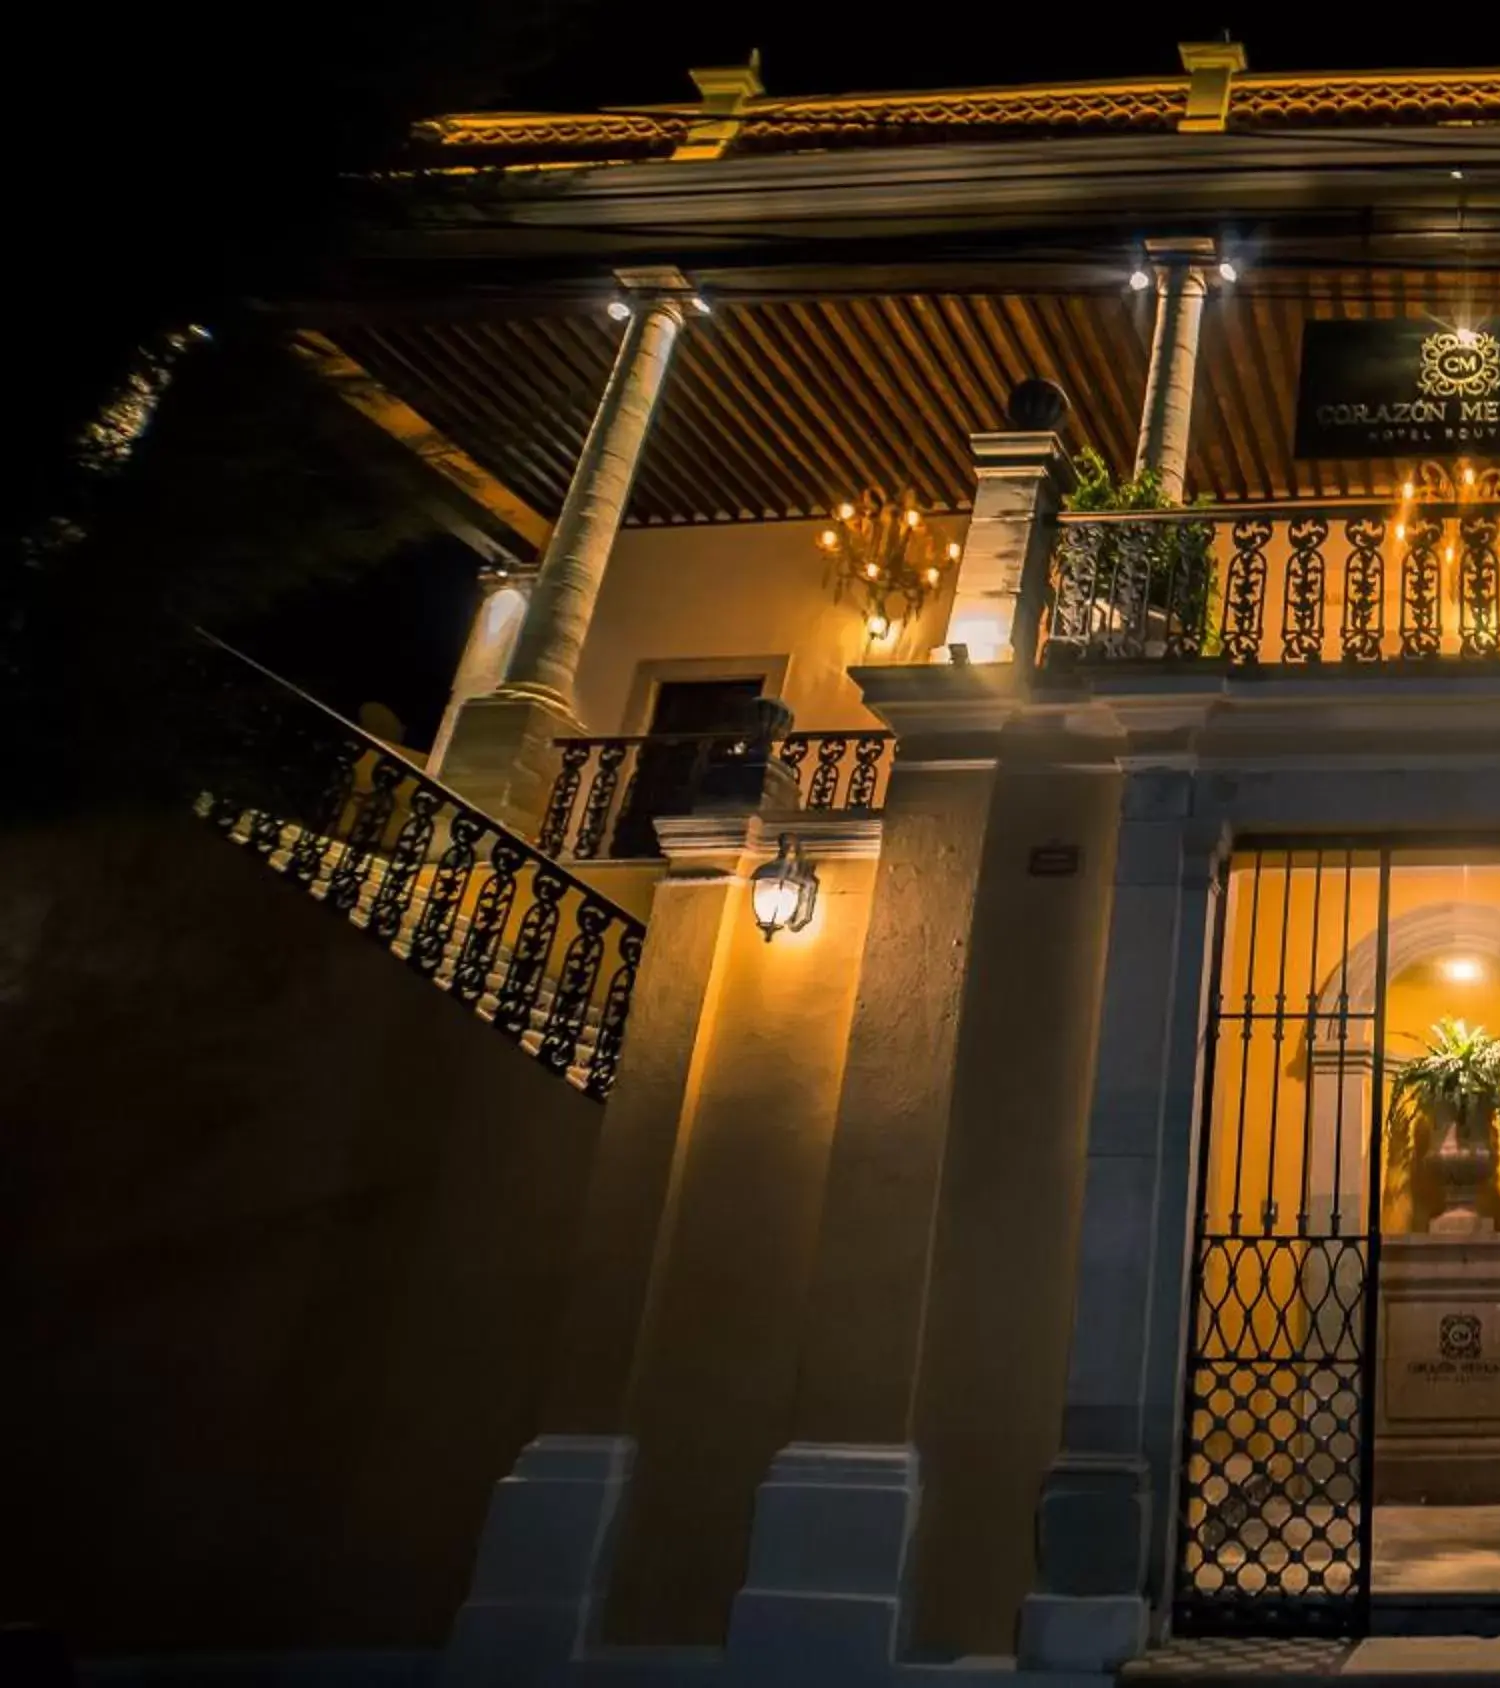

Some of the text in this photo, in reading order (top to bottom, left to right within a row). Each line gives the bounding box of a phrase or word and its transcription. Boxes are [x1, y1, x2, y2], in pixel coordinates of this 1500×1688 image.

[1444, 355, 1477, 373] CM
[1317, 399, 1447, 424] CORAZÓN
[1368, 427, 1432, 440] HOTEL
